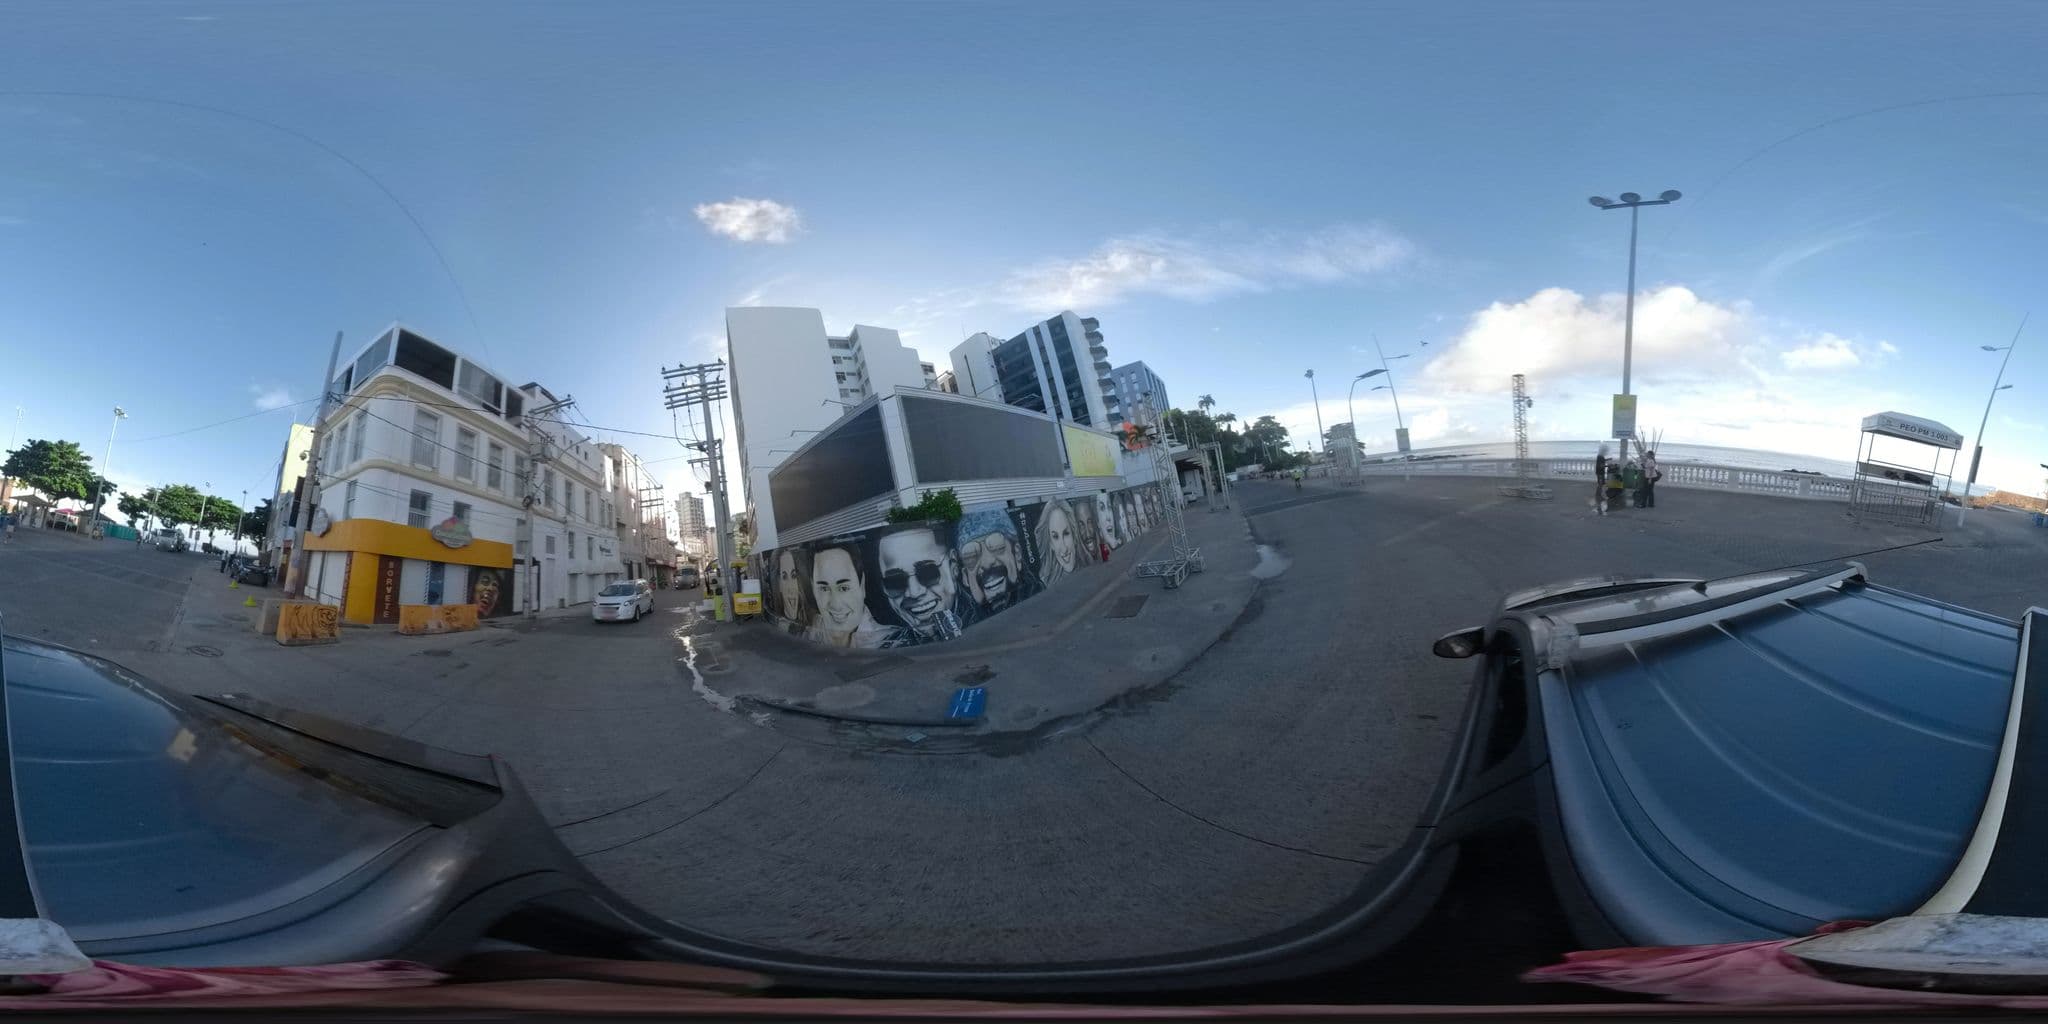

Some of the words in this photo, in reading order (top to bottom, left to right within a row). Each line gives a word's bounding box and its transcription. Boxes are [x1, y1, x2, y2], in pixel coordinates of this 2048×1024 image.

[1899, 423, 1917, 433] PEO
[1918, 427, 1929, 436] PM
[383, 560, 395, 618] SORVETE
